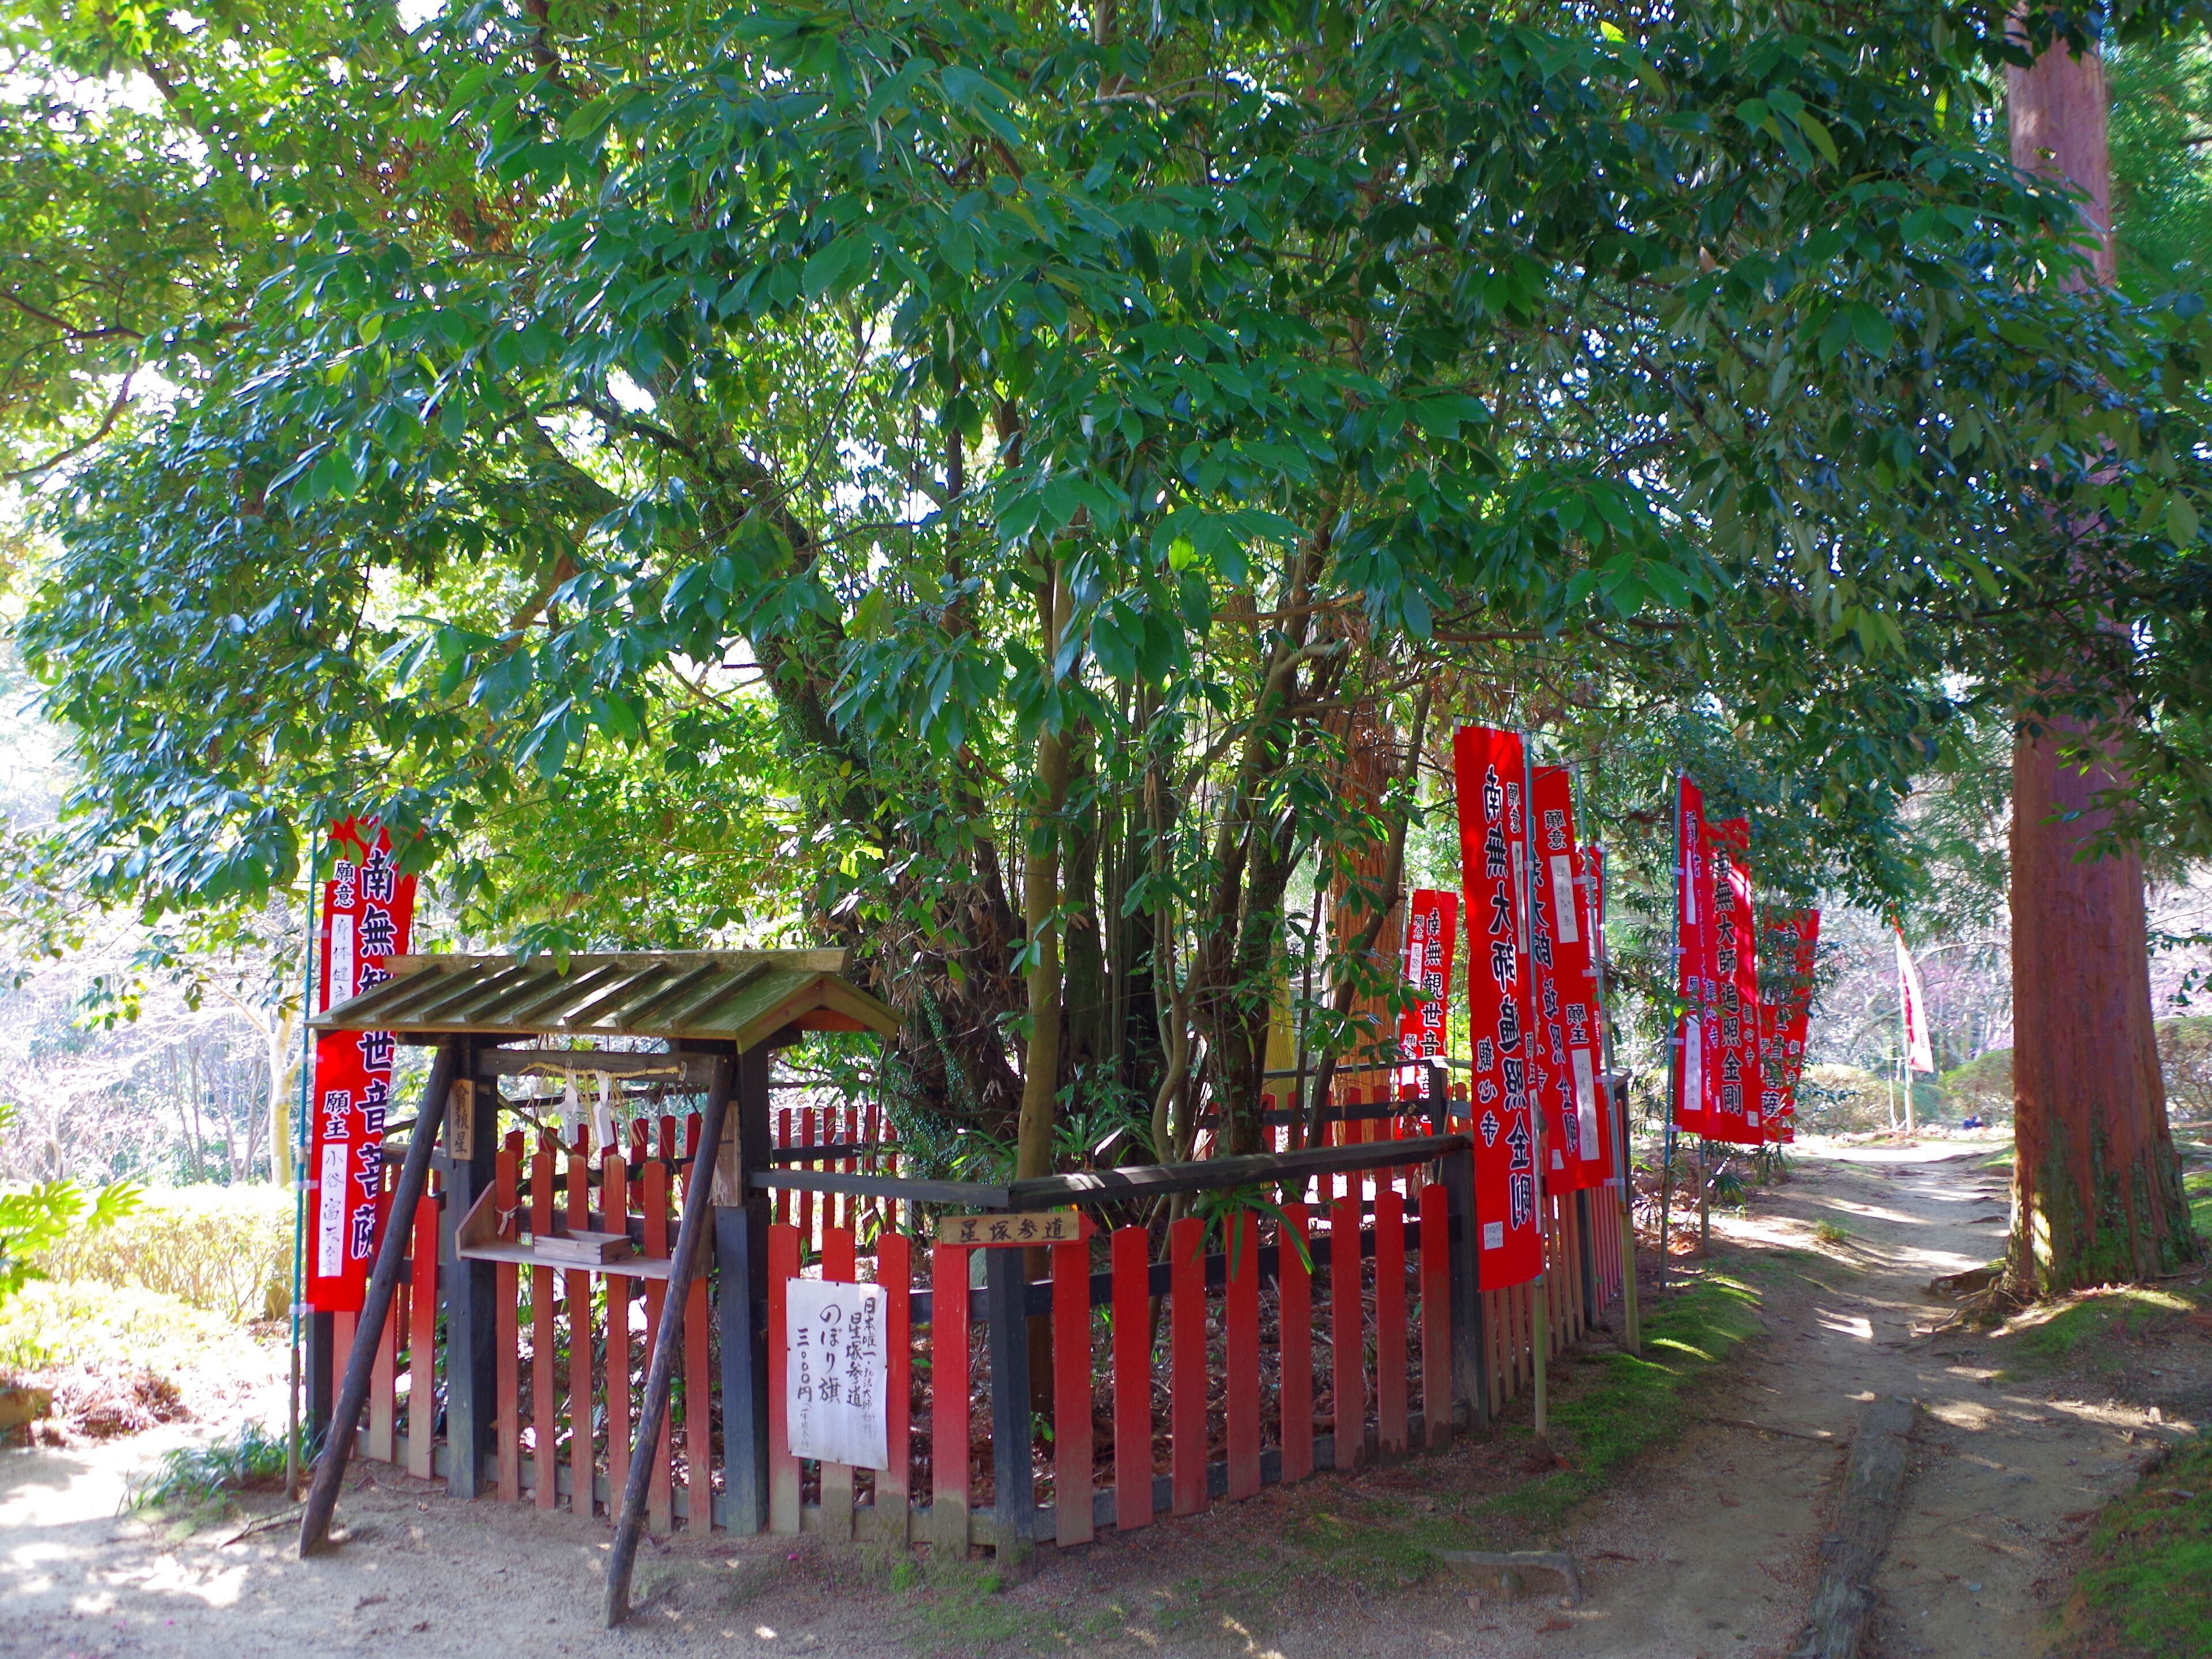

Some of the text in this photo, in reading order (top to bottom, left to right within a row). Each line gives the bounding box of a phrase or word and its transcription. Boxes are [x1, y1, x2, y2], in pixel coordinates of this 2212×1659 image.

[334, 859, 355, 908] 願意
[323, 1090, 351, 1140] 願主
[818, 1304, 842, 1404] のぼり旗
